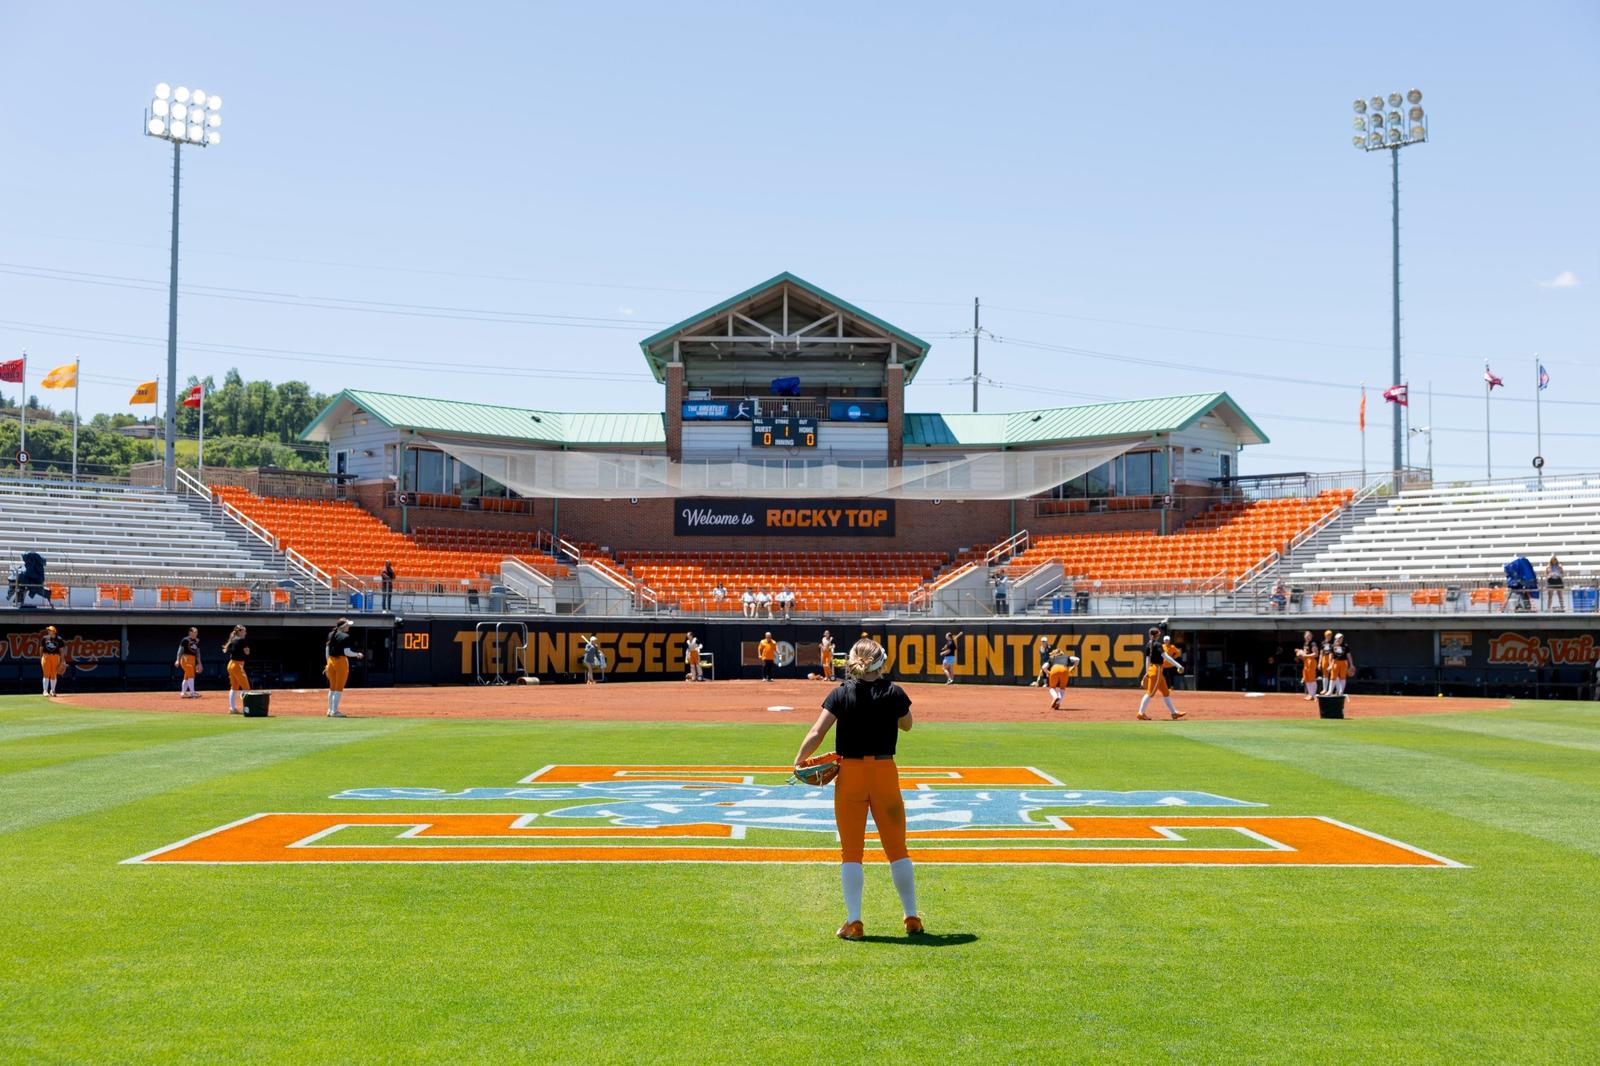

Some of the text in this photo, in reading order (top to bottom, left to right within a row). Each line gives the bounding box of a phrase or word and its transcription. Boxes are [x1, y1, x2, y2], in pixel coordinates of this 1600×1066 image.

[764, 433, 772, 445] 0
[806, 434, 814, 446] 0
[682, 508, 888, 527] Welcome to ROCKY TOP
[404, 633, 429, 649] 020
[1488, 632, 1549, 667] Lady
